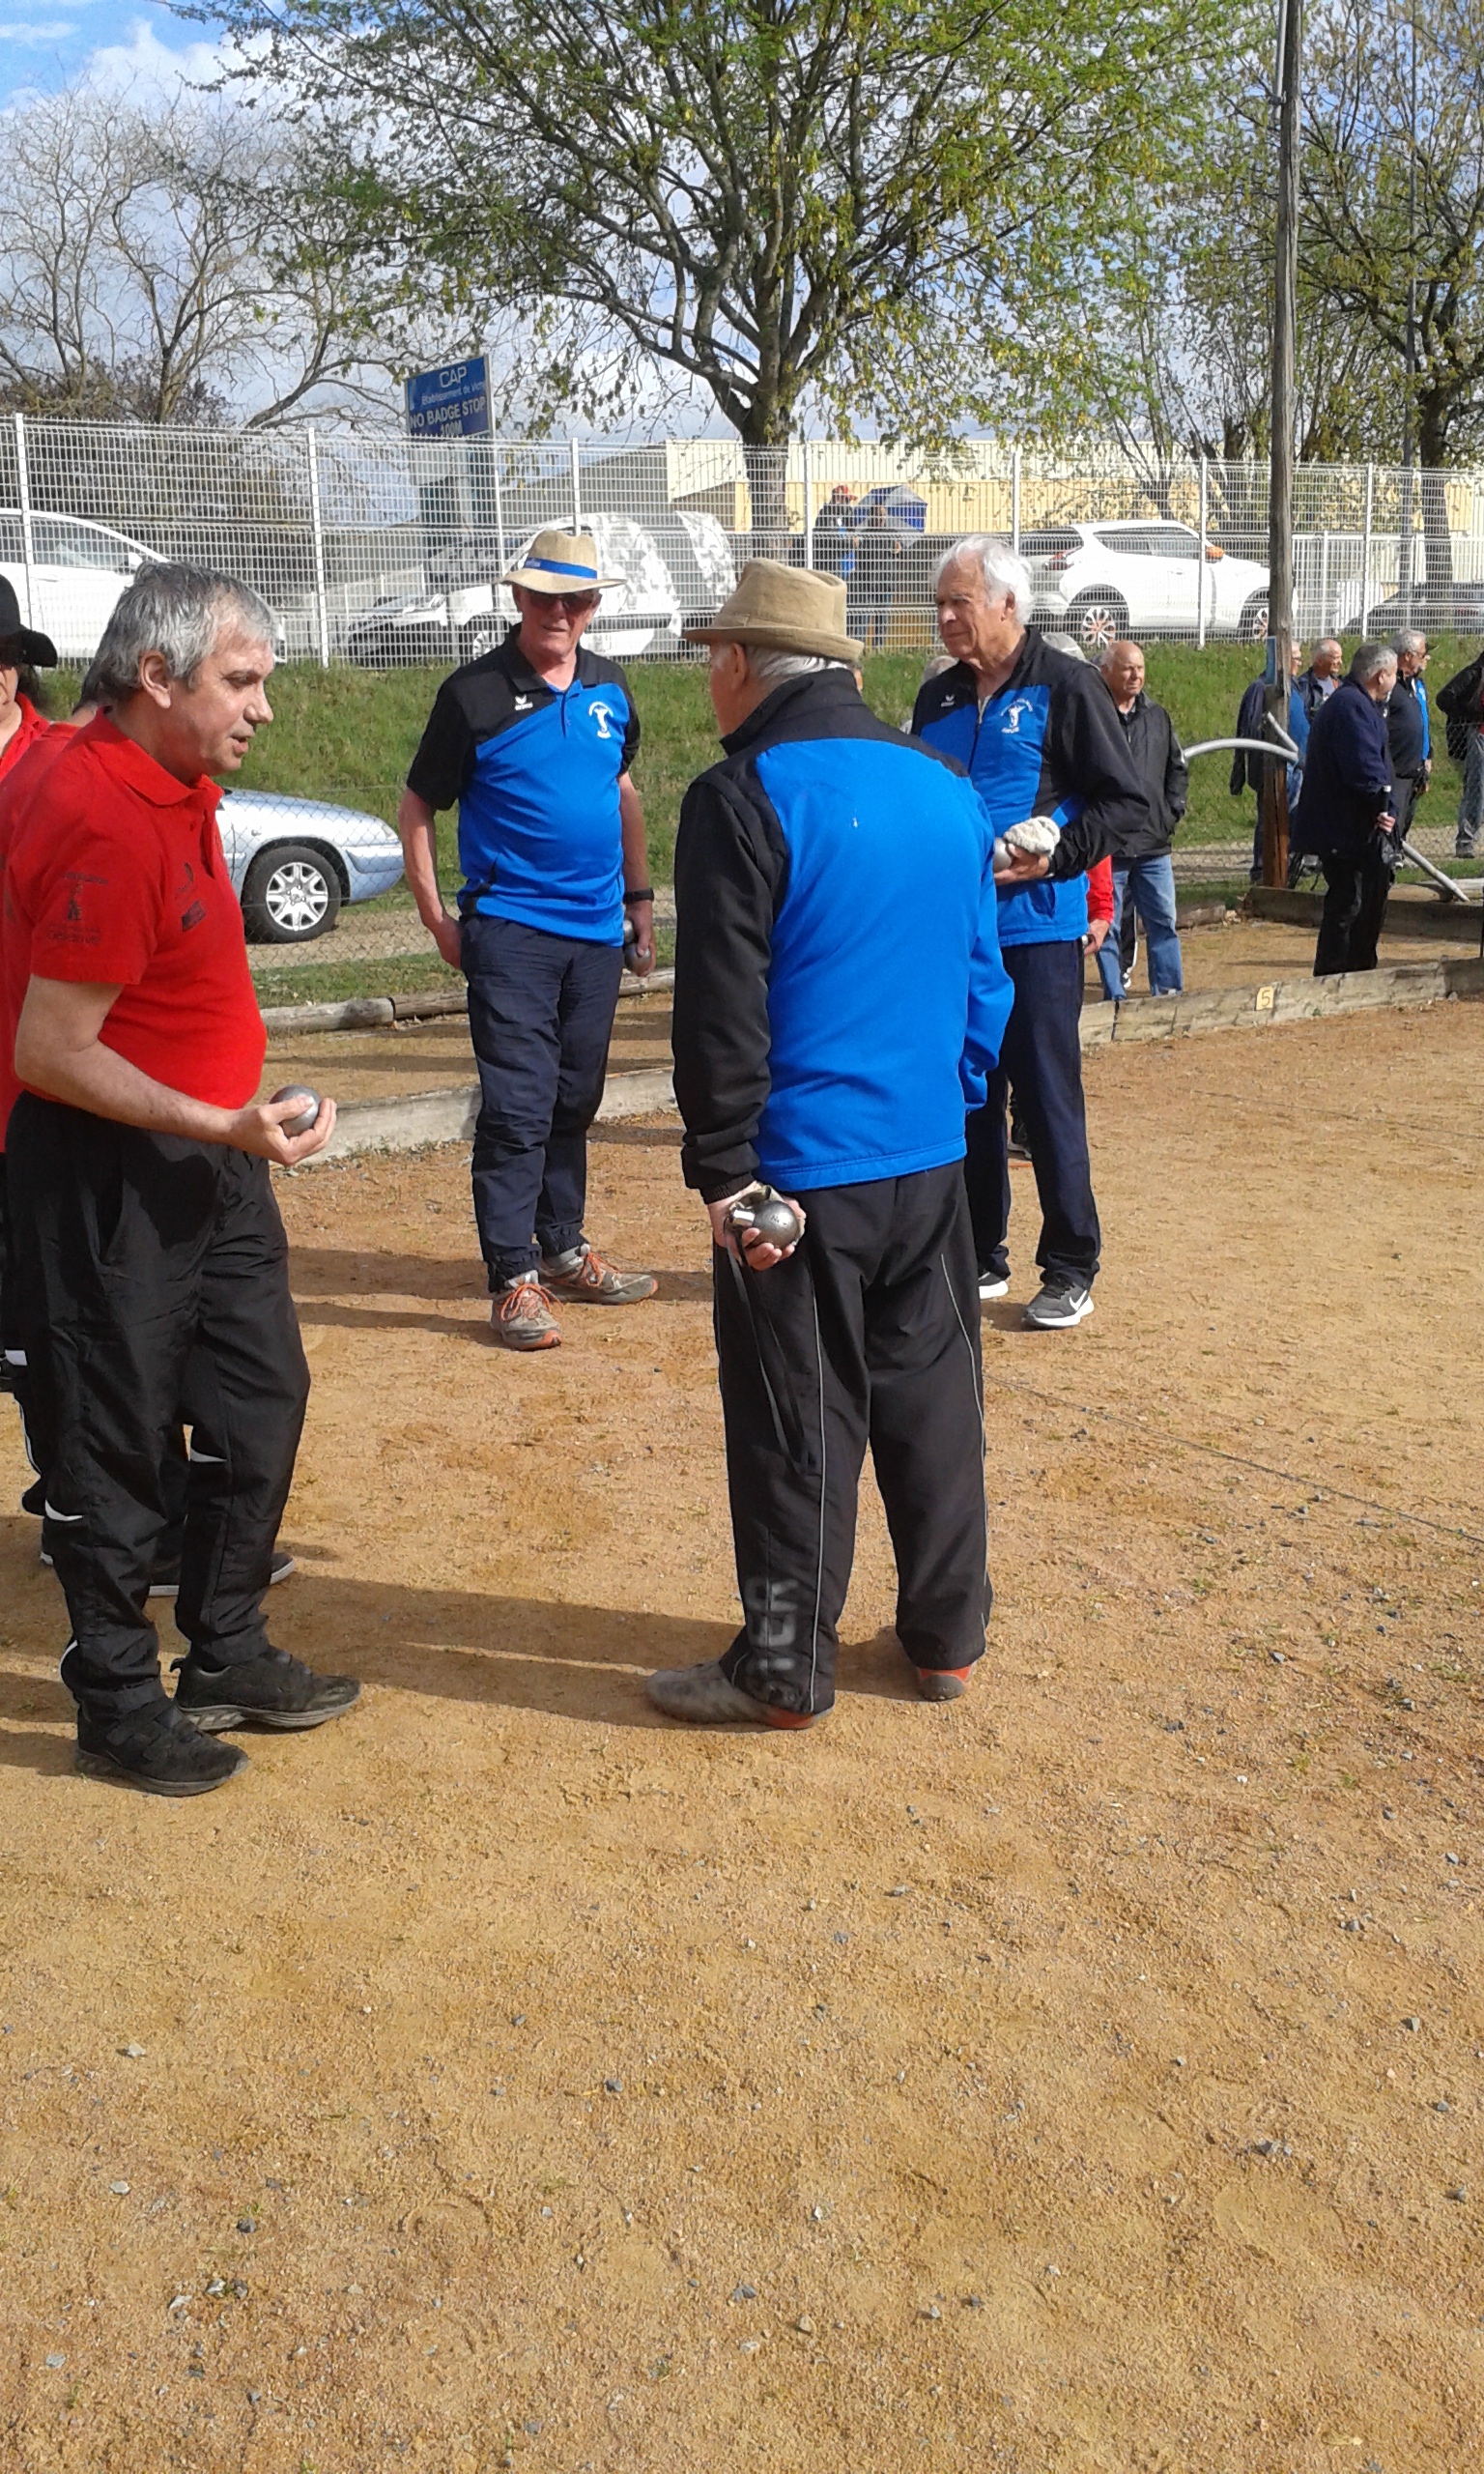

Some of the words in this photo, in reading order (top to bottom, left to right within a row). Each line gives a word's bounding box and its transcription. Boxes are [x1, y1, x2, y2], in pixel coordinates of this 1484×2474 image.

[440, 365, 467, 388] CAP
[410, 413, 425, 430] NO
[426, 403, 461, 426] BADGE
[462, 396, 486, 416] STOP
[441, 419, 463, 438] 100M
[1261, 990, 1270, 1007] 5
